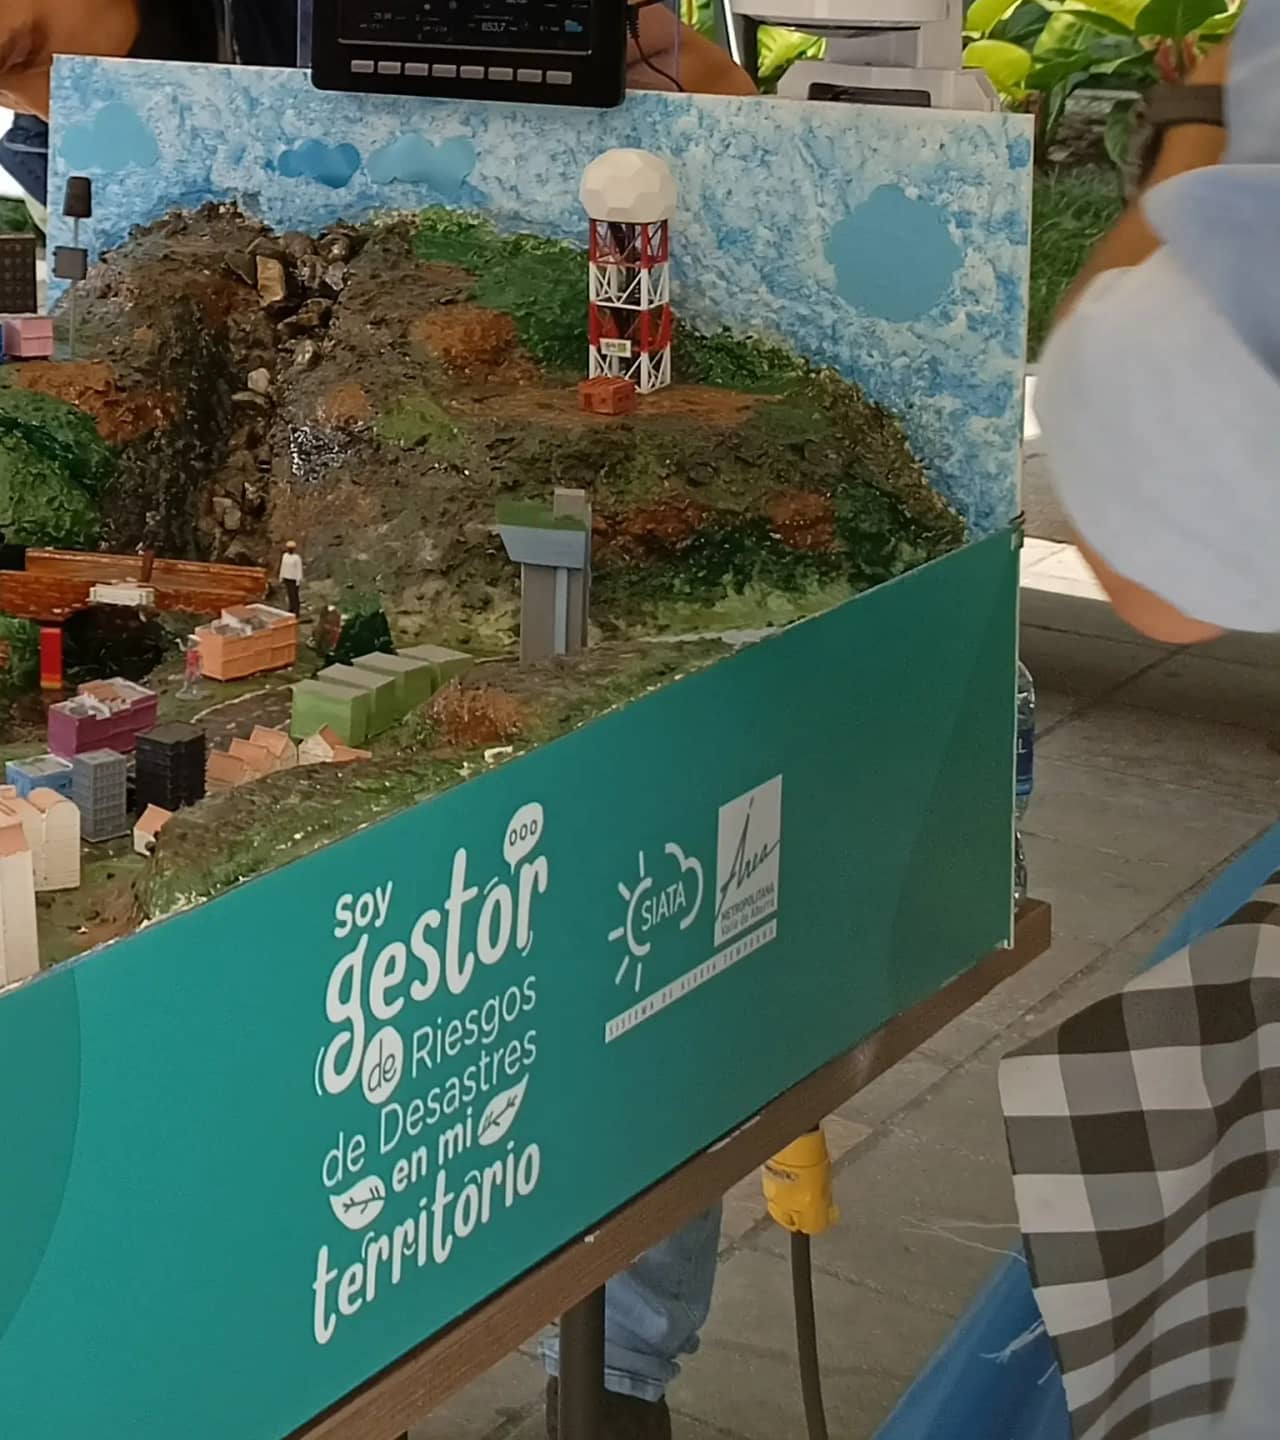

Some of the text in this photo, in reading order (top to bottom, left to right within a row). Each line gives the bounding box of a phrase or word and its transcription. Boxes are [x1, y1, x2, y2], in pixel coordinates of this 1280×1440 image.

[322, 847, 548, 1095] gestor
[641, 880, 687, 931] SIATA
[367, 975, 536, 1093] de Riesgos
[322, 1030, 537, 1188] de Desastres
[391, 1106, 473, 1192] en mi
[312, 1140, 540, 1344] territorio
